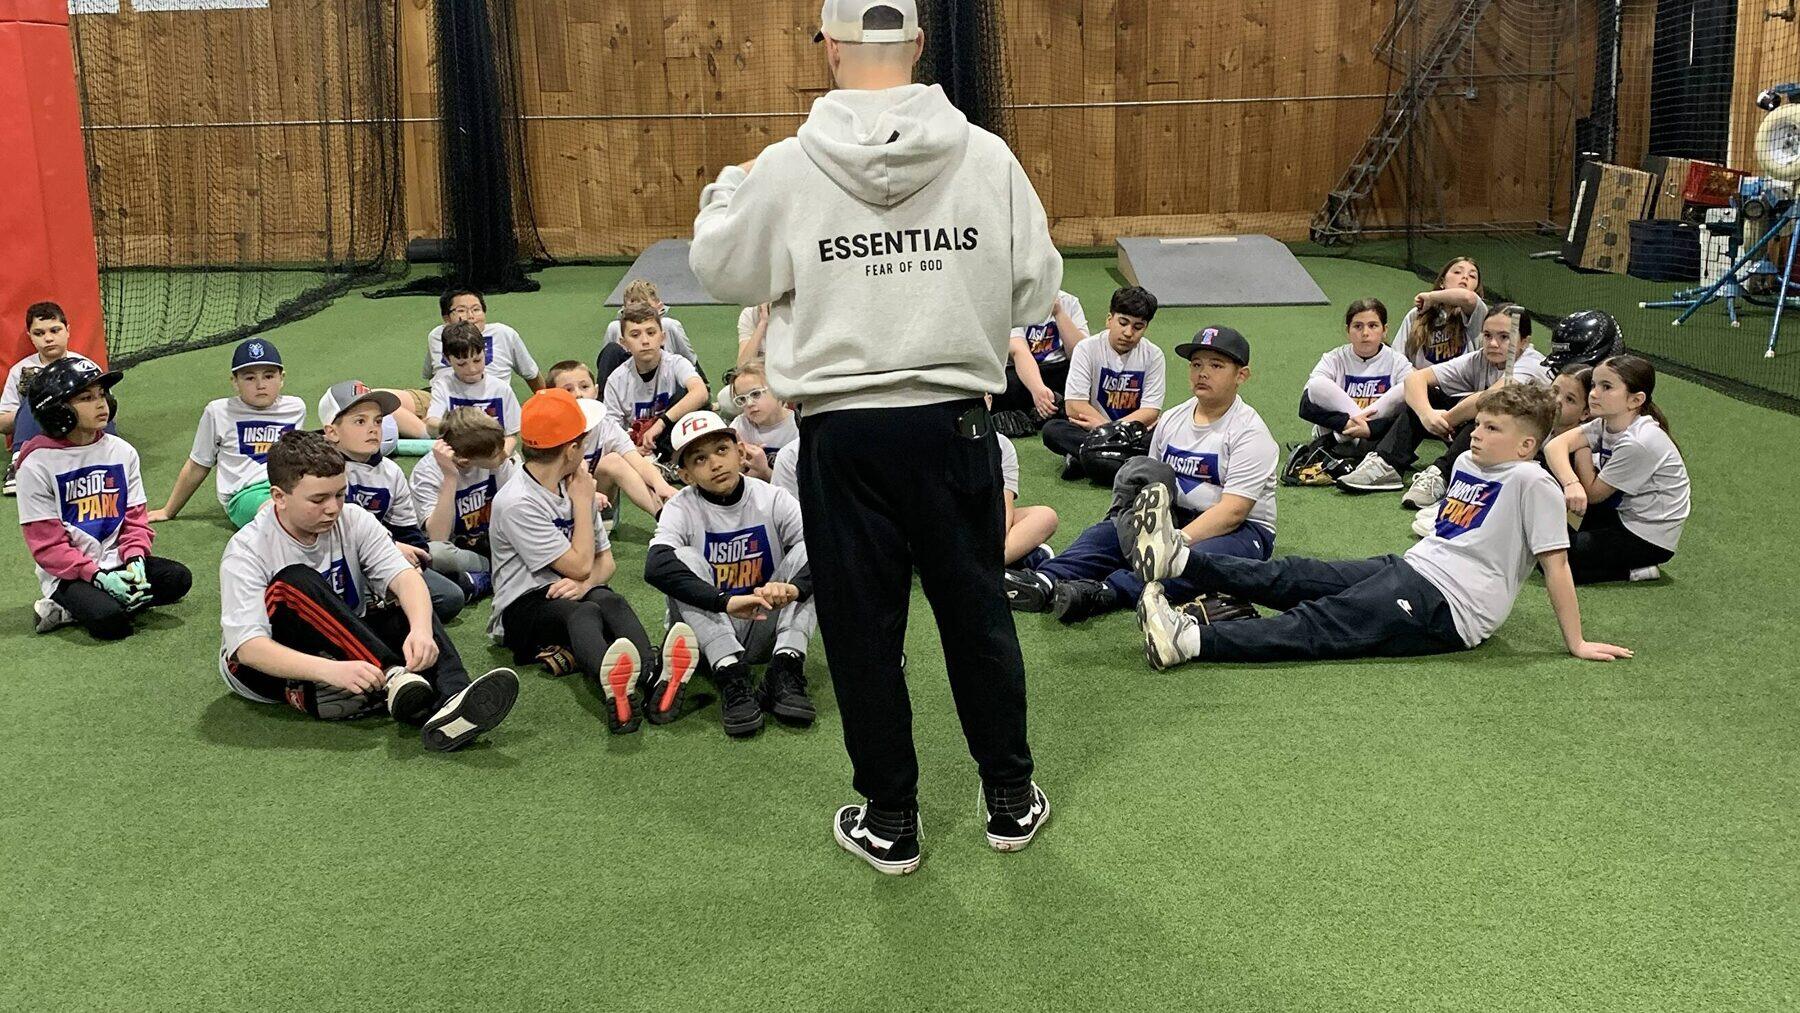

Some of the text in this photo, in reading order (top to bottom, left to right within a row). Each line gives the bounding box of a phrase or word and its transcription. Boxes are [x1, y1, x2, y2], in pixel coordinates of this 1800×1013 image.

[818, 226, 979, 263] ESSENTIALS
[865, 259, 943, 277] FEAR OF GOD
[682, 416, 708, 436] FC
[68, 493, 120, 523] PARK
[708, 532, 764, 563] NSiDE
[711, 557, 764, 591] PARK
